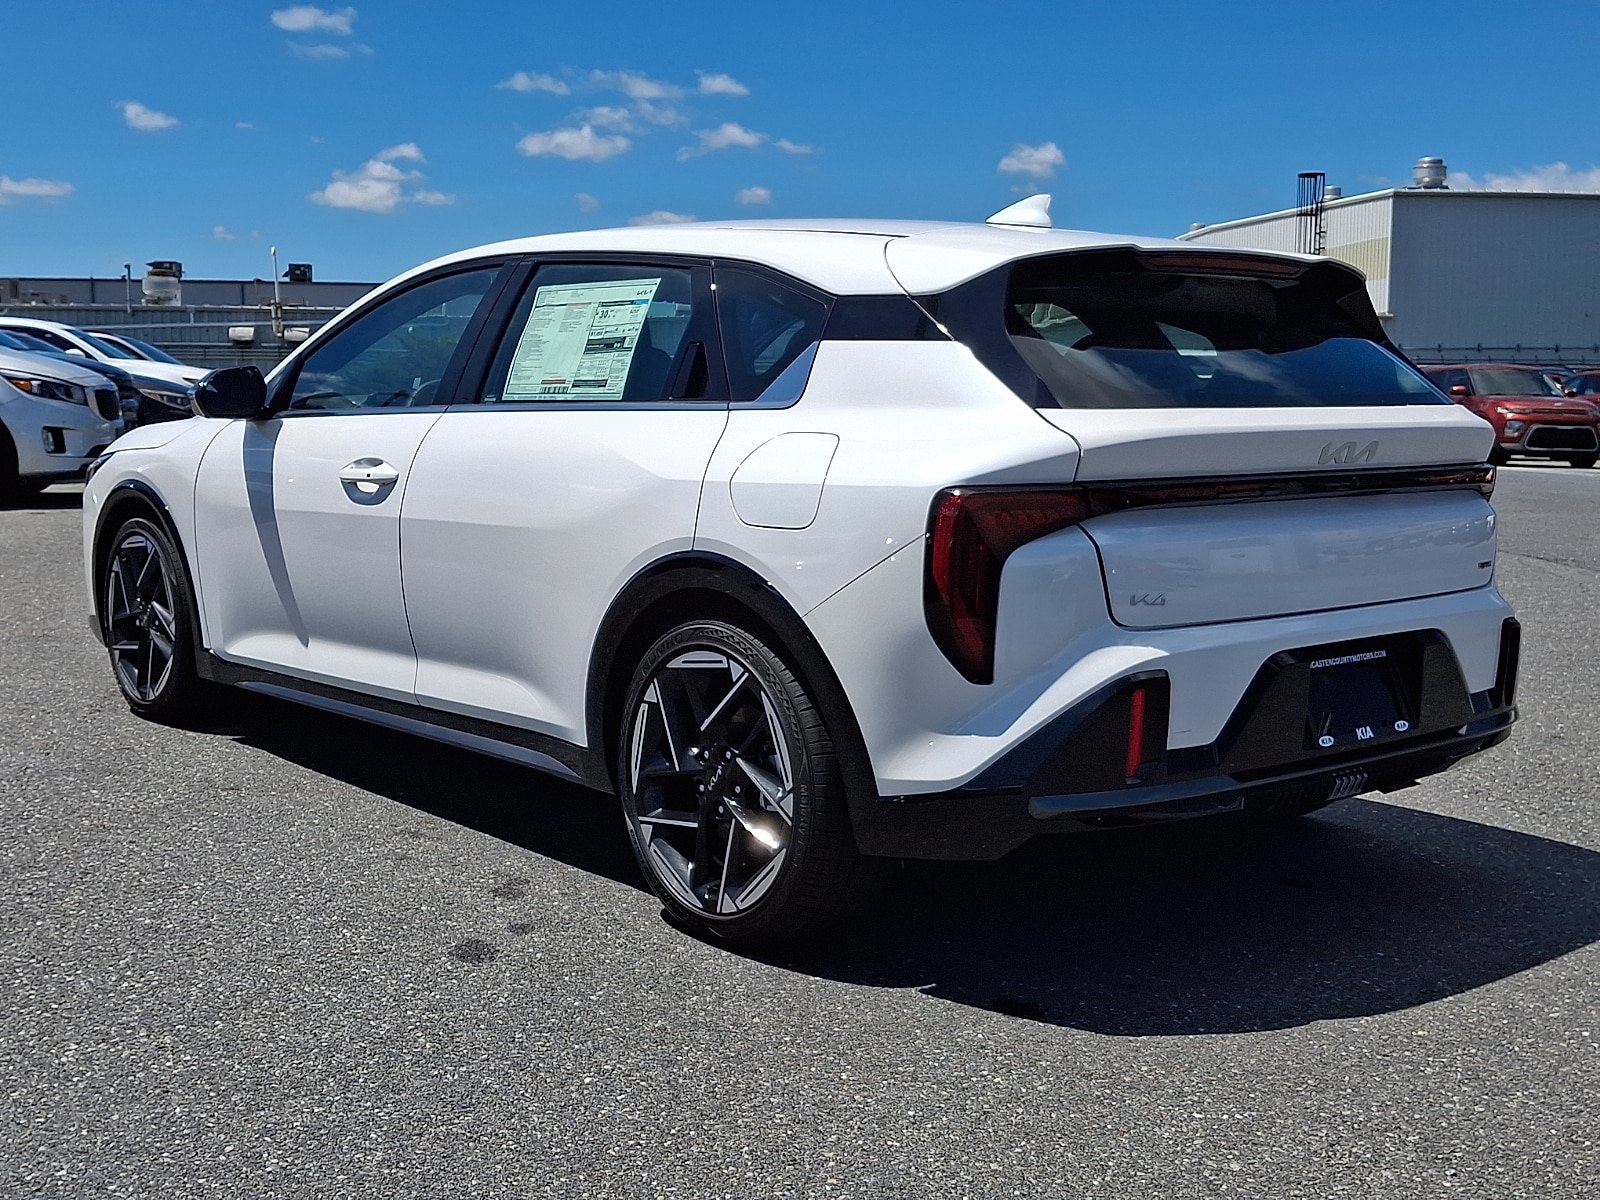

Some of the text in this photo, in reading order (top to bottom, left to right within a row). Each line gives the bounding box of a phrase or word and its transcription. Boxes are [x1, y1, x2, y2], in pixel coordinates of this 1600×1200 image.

[598, 310, 609, 319] 30
[1317, 440, 1379, 465] KIA
[1129, 592, 1166, 606] K4
[1309, 650, 1387, 669] CASTERCOUNTYMOTORS.COM
[1396, 721, 1407, 730] KIA
[1356, 726, 1374, 740] KIA
[1320, 737, 1333, 745] KIA
